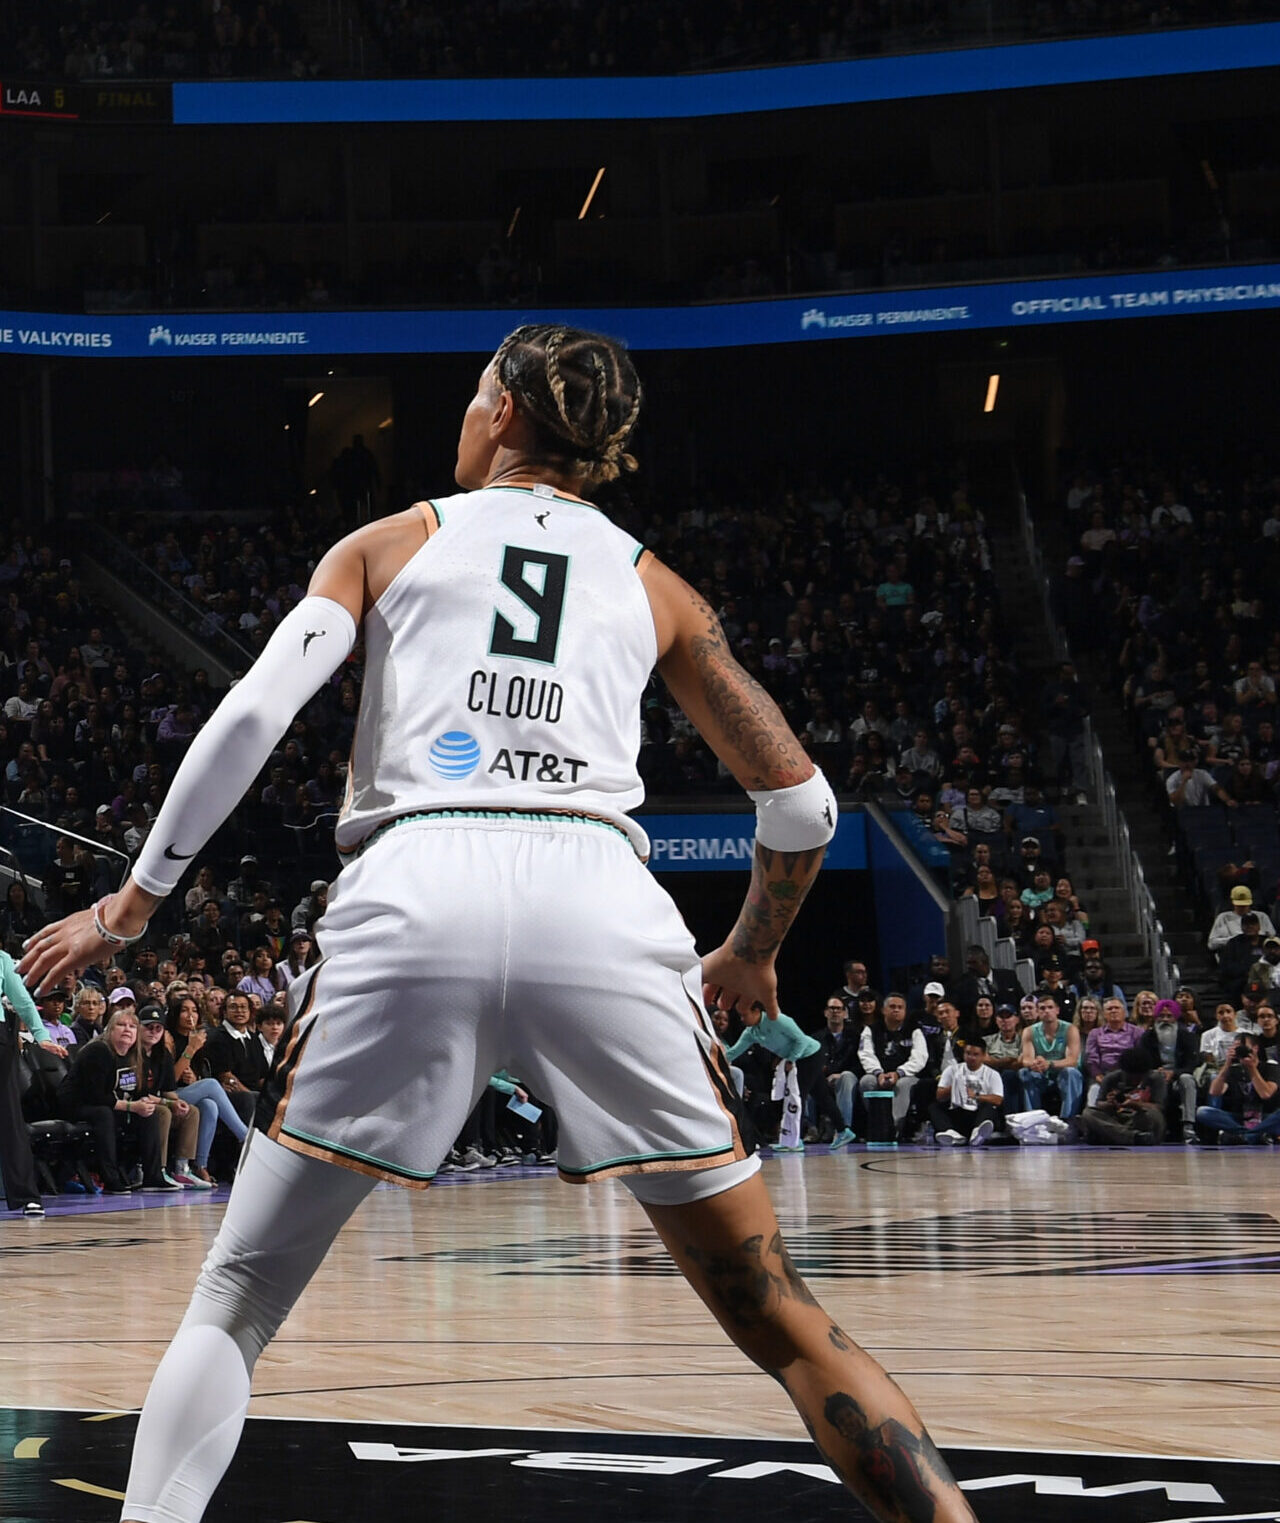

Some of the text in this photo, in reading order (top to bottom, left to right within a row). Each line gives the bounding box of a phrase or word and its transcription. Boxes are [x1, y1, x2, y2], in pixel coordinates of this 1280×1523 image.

[6, 88, 157, 108] LAA 5 FINAL
[1011, 295, 1106, 316] OFFICIAL
[1111, 291, 1168, 310] TEAM
[827, 306, 970, 328] KAISER PERMANENTE
[18, 330, 112, 348] VALKYRIES
[175, 332, 307, 345] KAISER PERMANENTE
[486, 543, 572, 668] 9
[467, 670, 564, 724] CLOUD
[488, 748, 588, 784] AT&T
[652, 838, 755, 860] PERMAN
